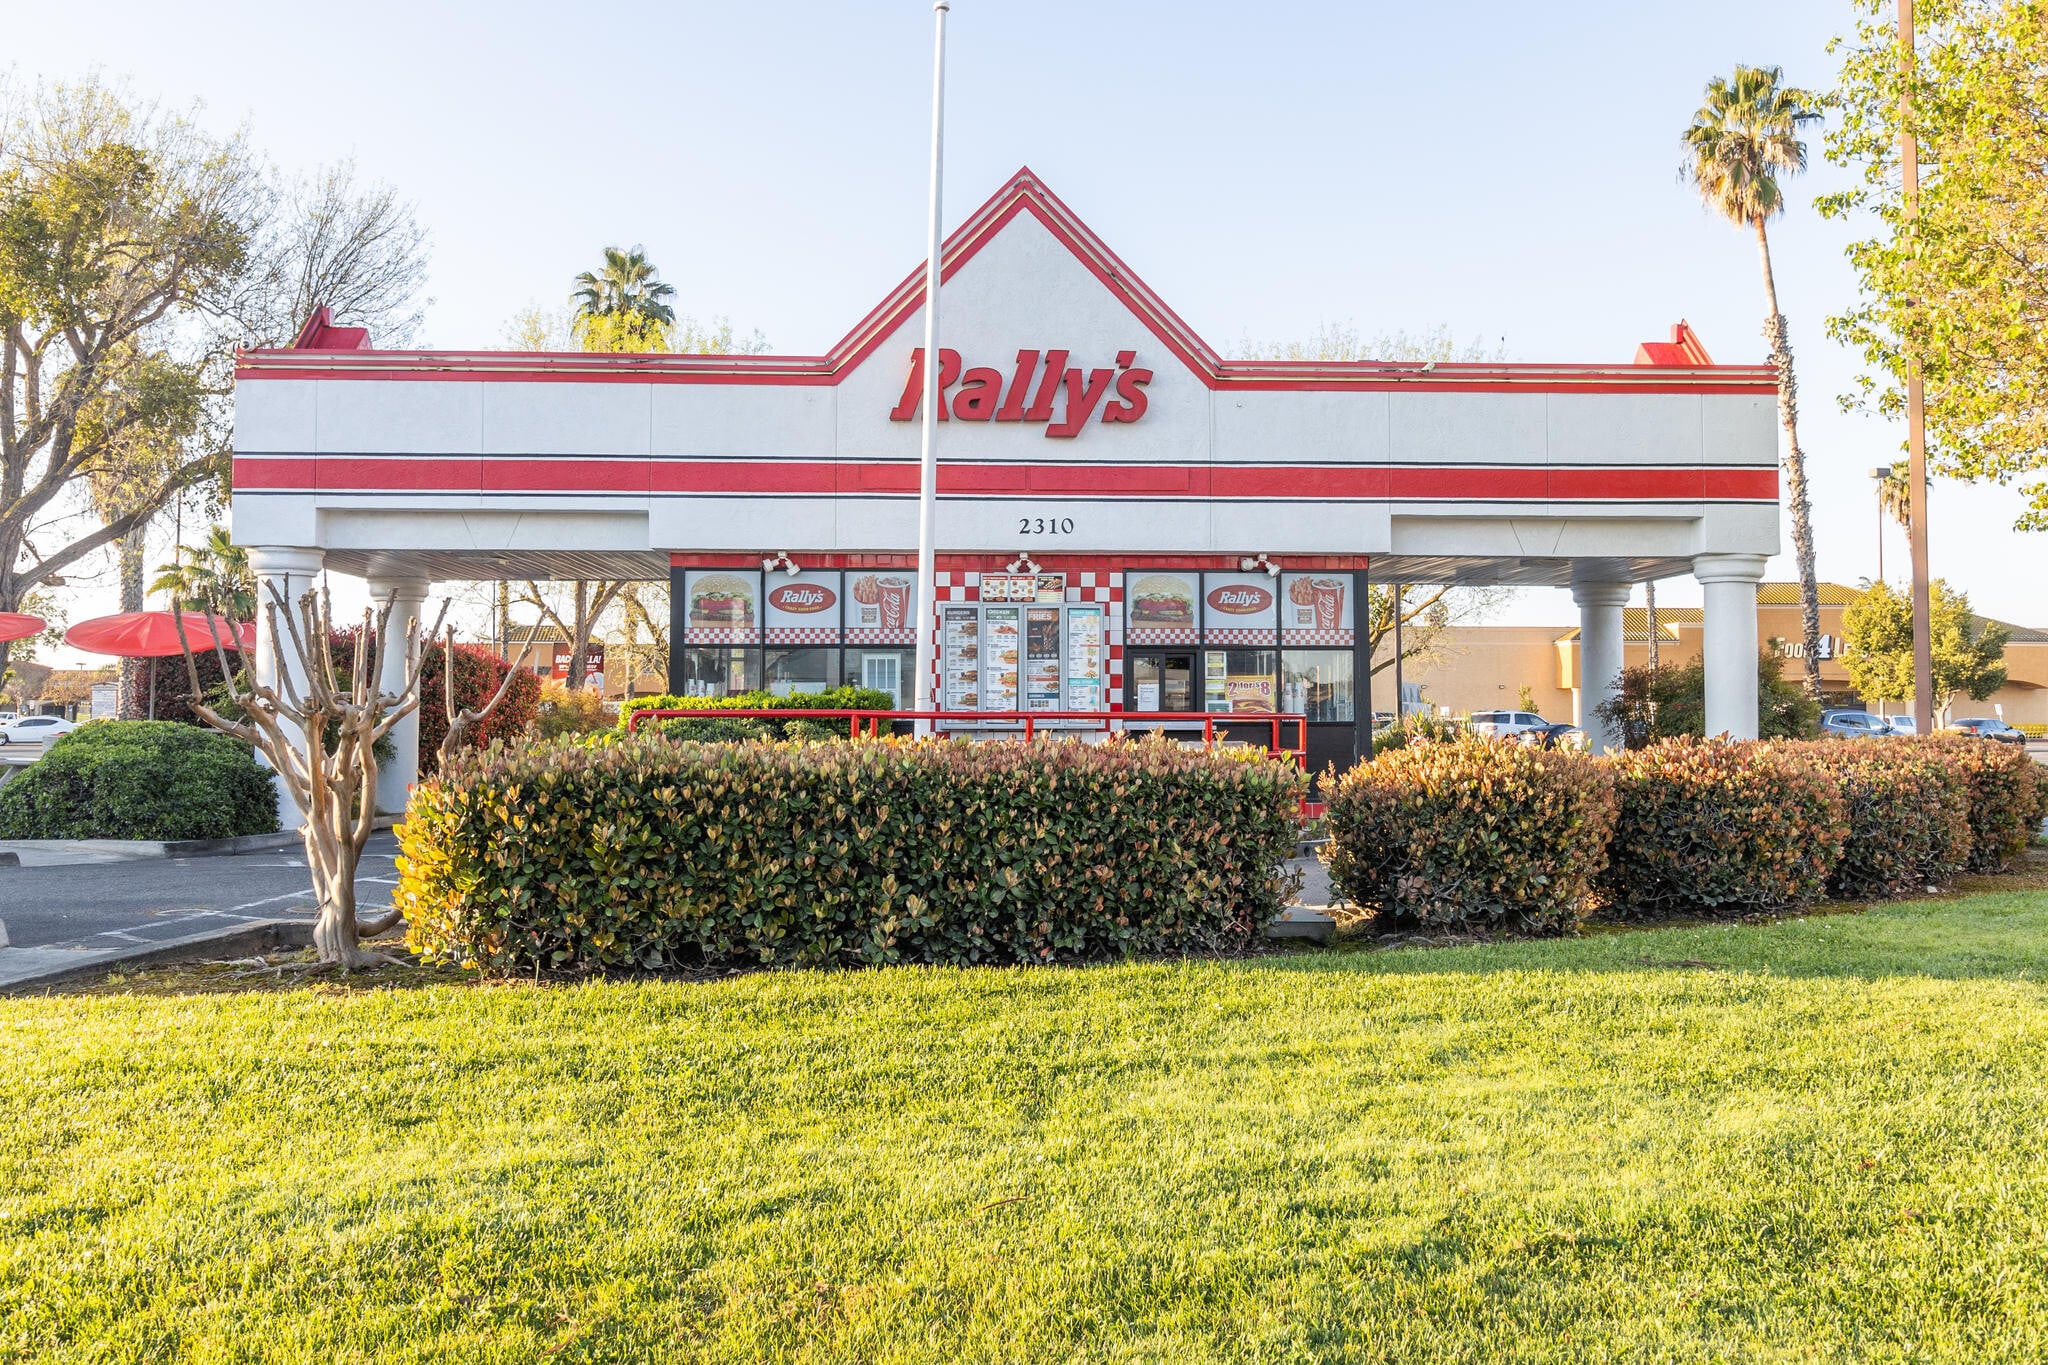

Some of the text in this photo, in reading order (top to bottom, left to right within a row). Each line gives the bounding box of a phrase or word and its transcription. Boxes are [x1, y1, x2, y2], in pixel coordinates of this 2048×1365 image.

[889, 347, 1154, 438] Rally's
[1019, 518, 1074, 535] 2310
[780, 590, 824, 606] Rally's
[1218, 591, 1261, 607] Rally's
[1028, 613, 1053, 621] FRIES
[1817, 633, 1832, 660] 4
[1228, 681, 1238, 697] 2
[1239, 681, 1252, 690] for
